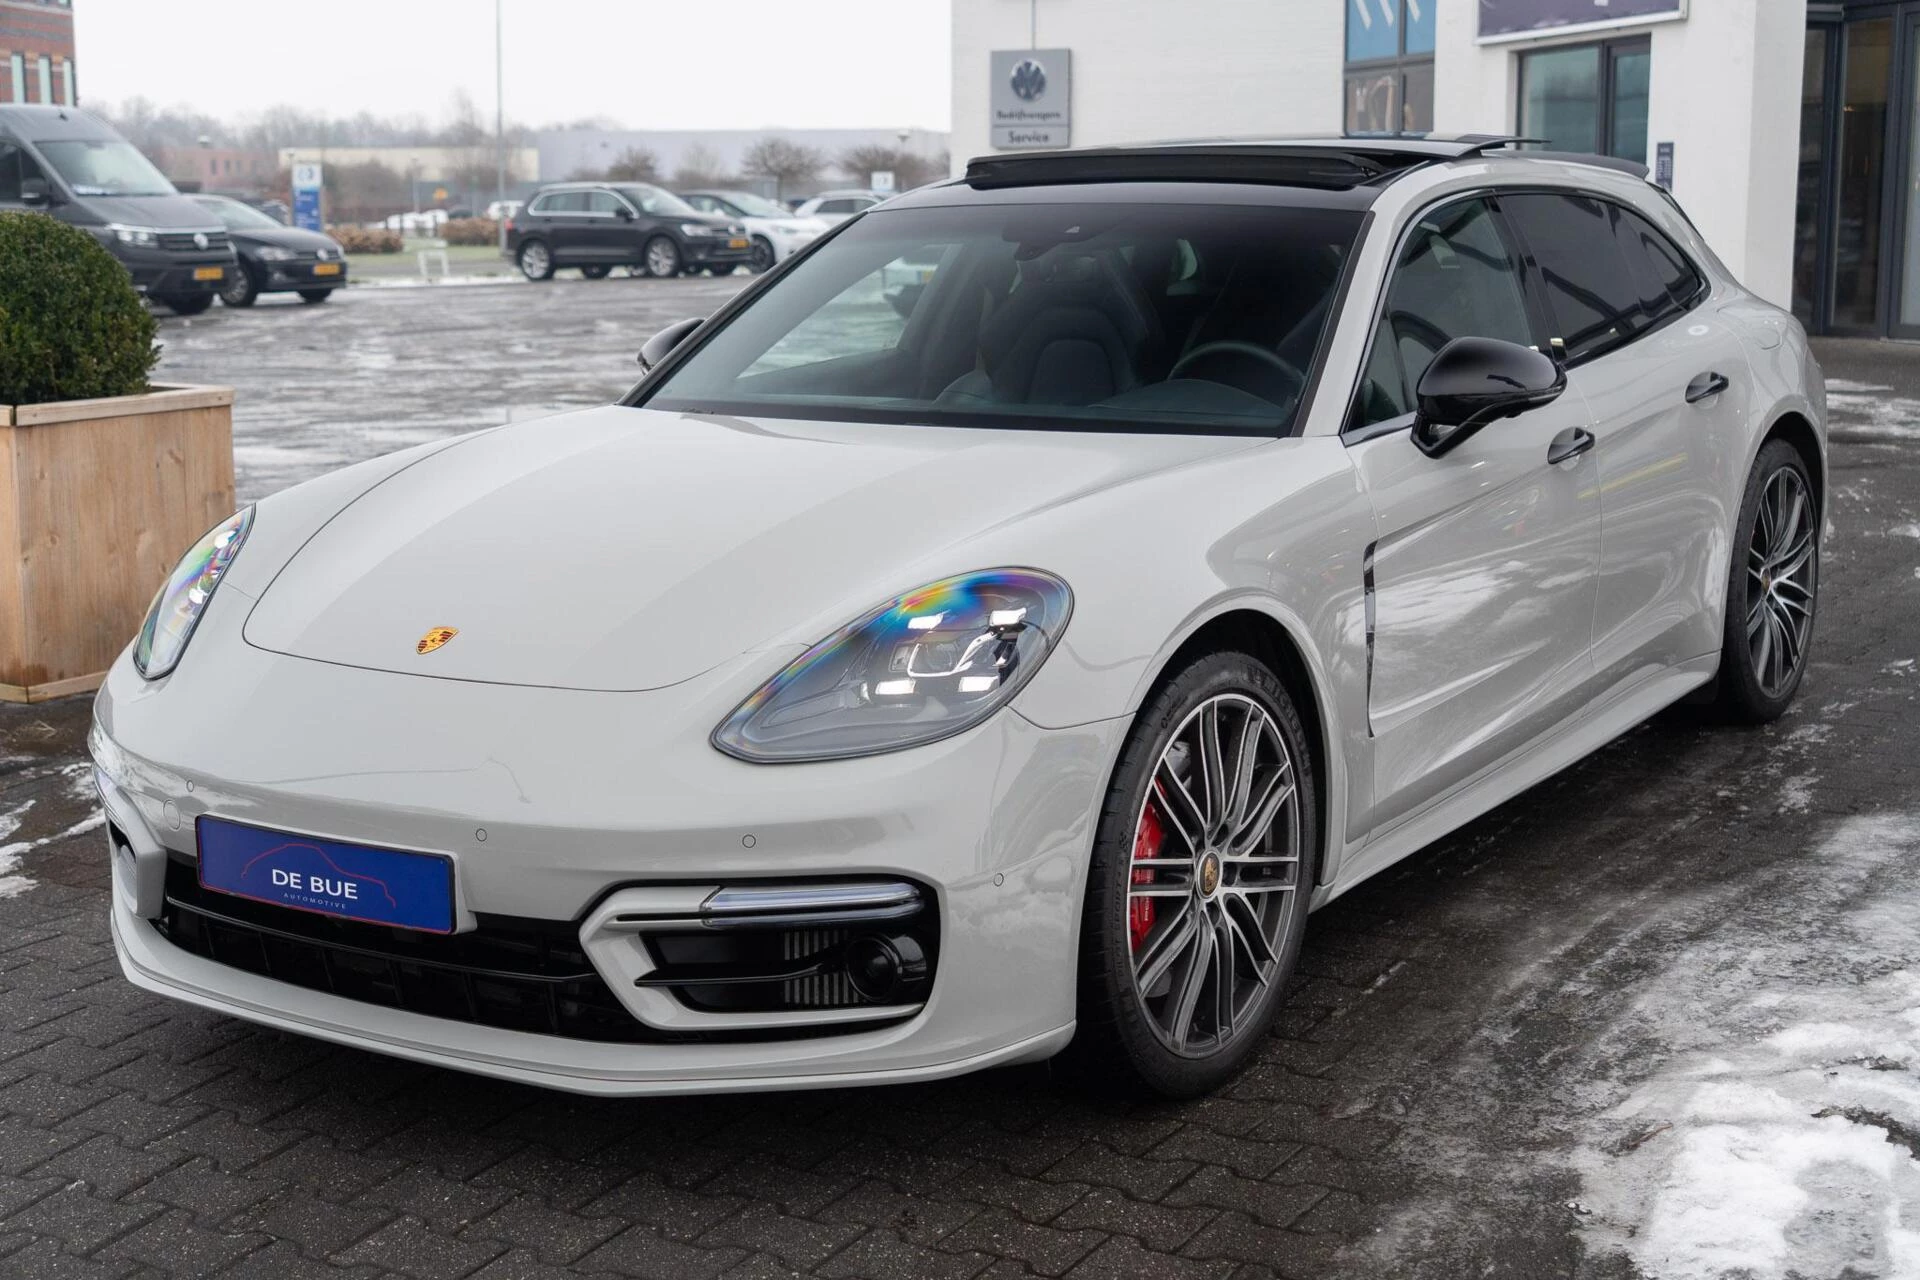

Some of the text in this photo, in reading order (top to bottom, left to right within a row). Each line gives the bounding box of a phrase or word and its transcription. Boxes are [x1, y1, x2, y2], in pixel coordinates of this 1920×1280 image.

[1008, 131, 1049, 144] Service
[272, 868, 358, 900] DE BUE
[283, 892, 346, 909] AUTOMOTIVE
